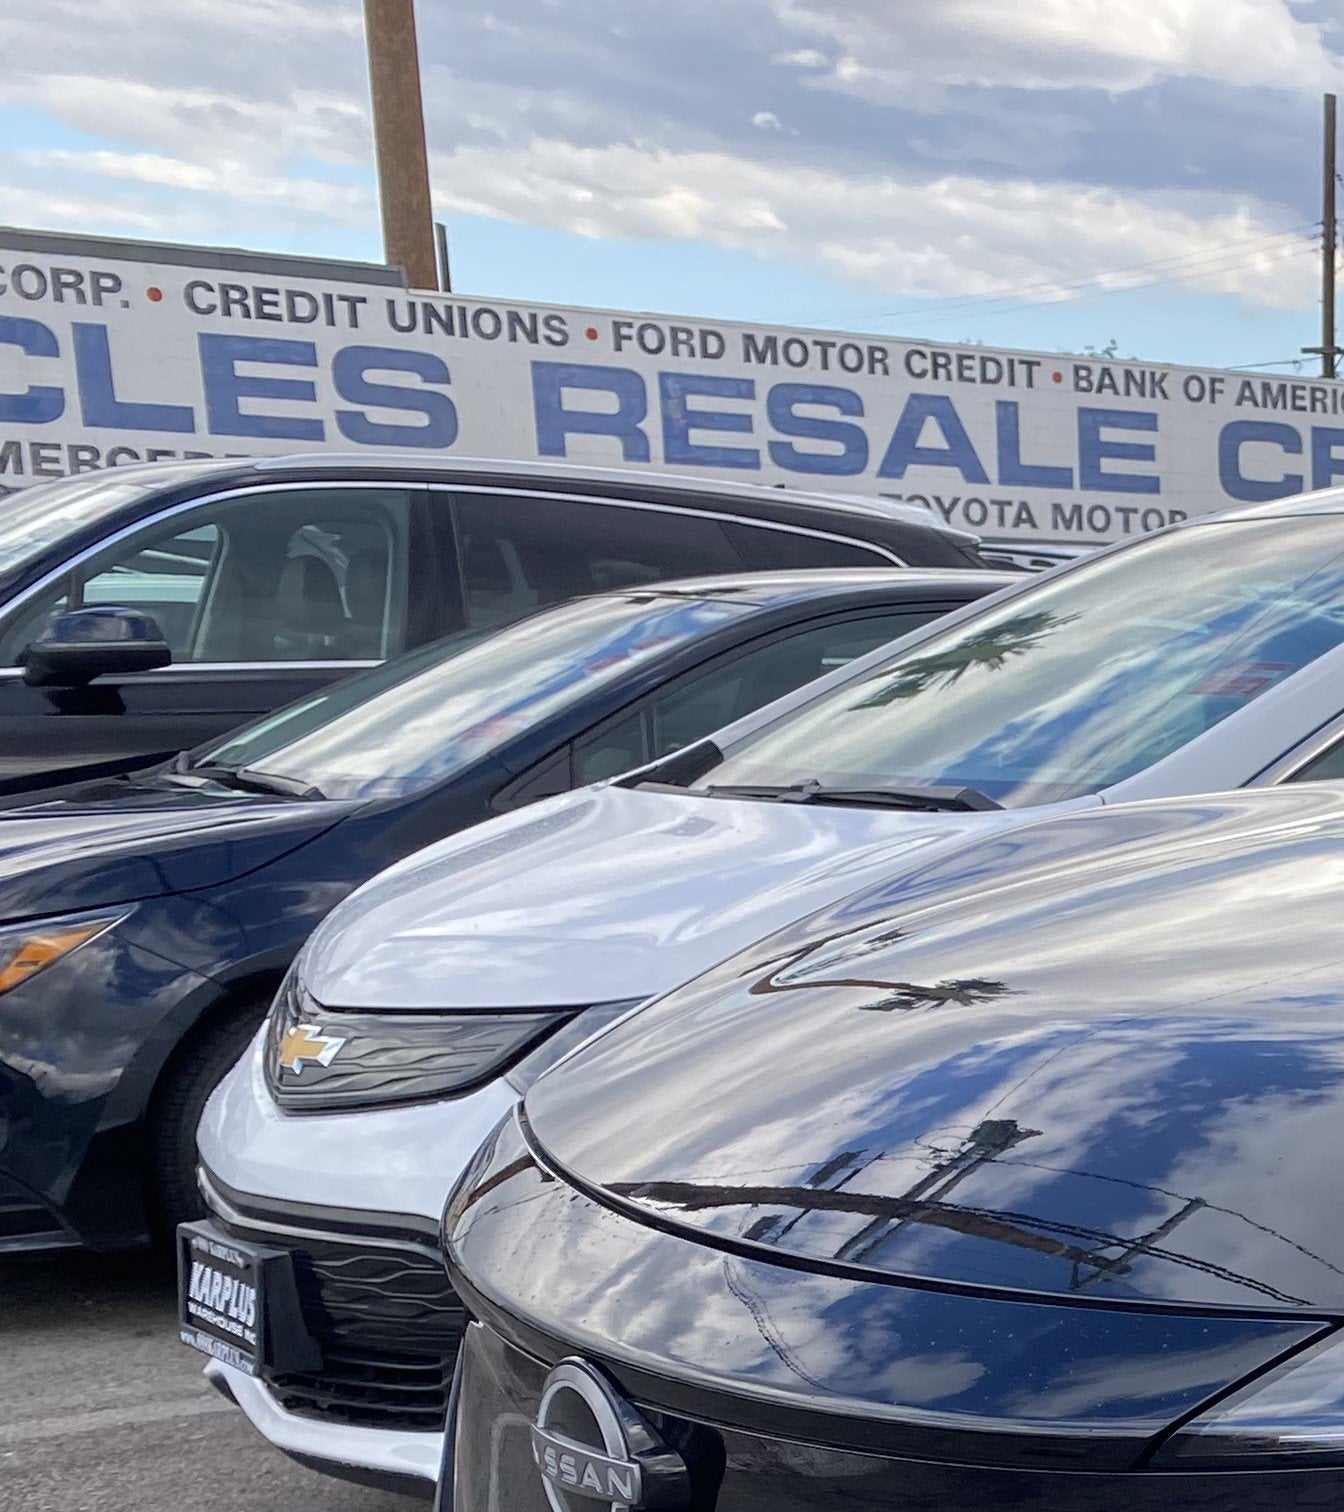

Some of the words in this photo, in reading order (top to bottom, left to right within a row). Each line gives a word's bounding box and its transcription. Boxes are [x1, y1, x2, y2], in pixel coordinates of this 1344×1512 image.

[183, 279, 367, 329] CREDIT
[386, 299, 571, 347] UNIONS
[612, 319, 726, 360] FORD
[742, 333, 890, 377] MOTOR
[904, 348, 1041, 389] CREDIT
[1072, 363, 1169, 400] BANK
[1183, 374, 1226, 404] OF
[530, 359, 1161, 495] RESALE
[878, 493, 1038, 530] YOTA
